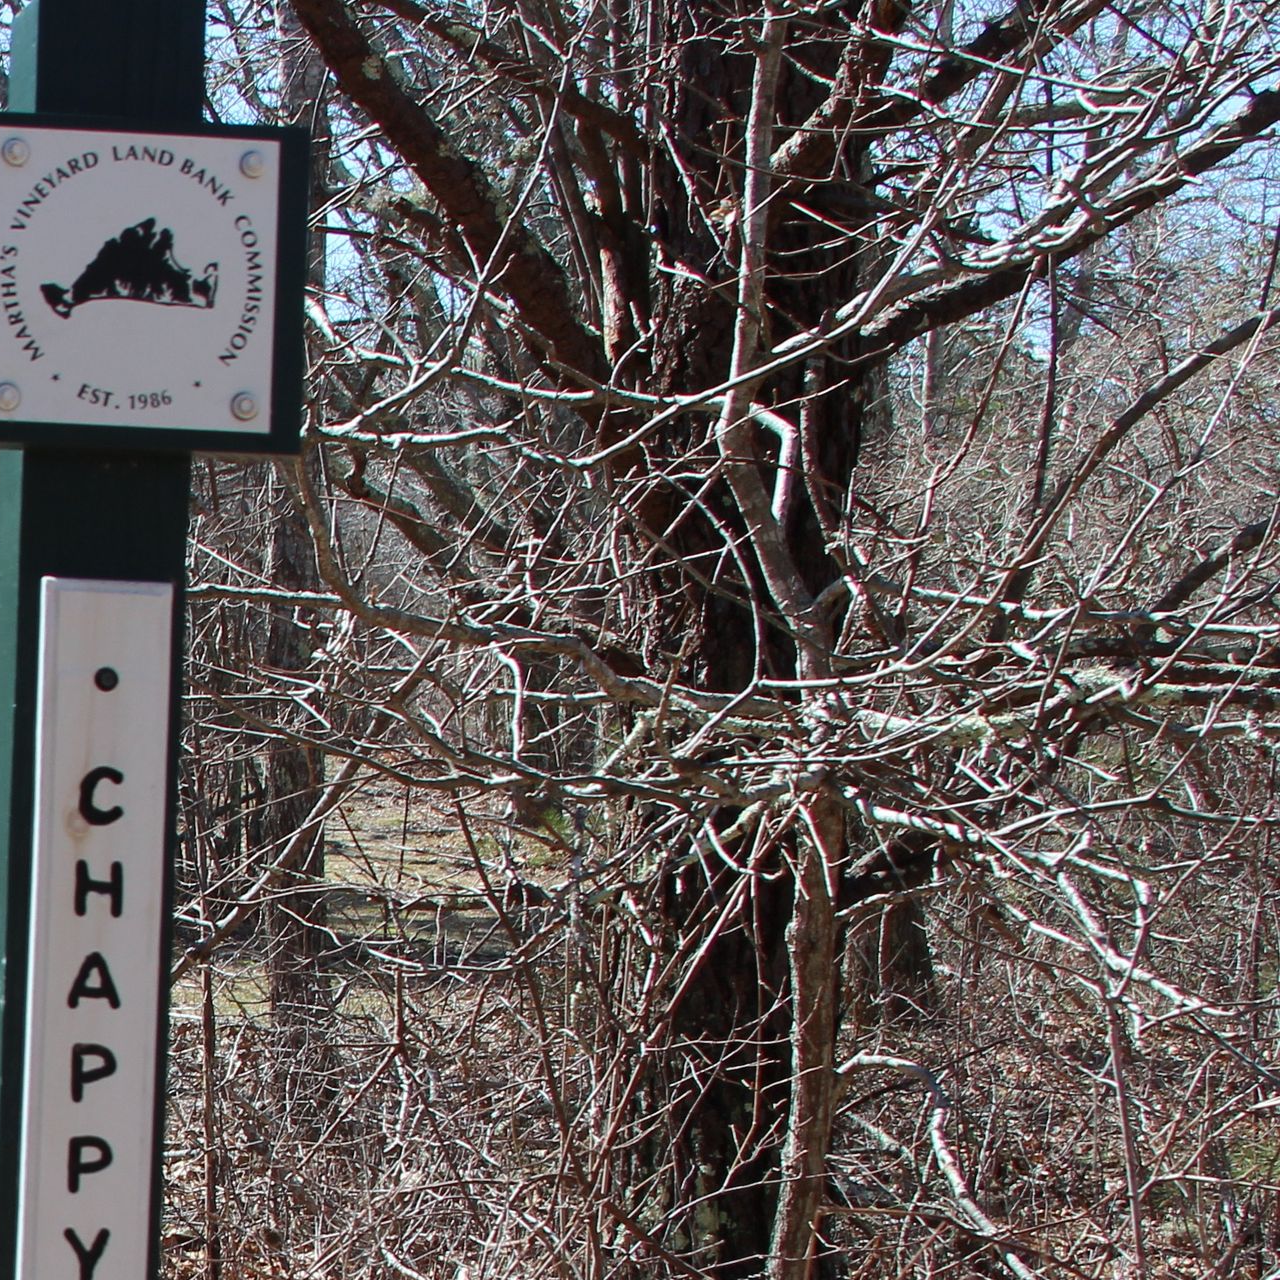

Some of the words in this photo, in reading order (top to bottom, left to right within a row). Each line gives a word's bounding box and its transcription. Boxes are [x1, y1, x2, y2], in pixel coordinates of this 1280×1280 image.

[111, 144, 175, 168] LAND
[179, 159, 235, 207] BANK
[10, 151, 100, 231] VINEYARD
[0, 244, 45, 362] MARTHA'S
[217, 214, 263, 367] COMMISSION
[77, 383, 120, 410] EST.
[128, 389, 173, 411] 1986
